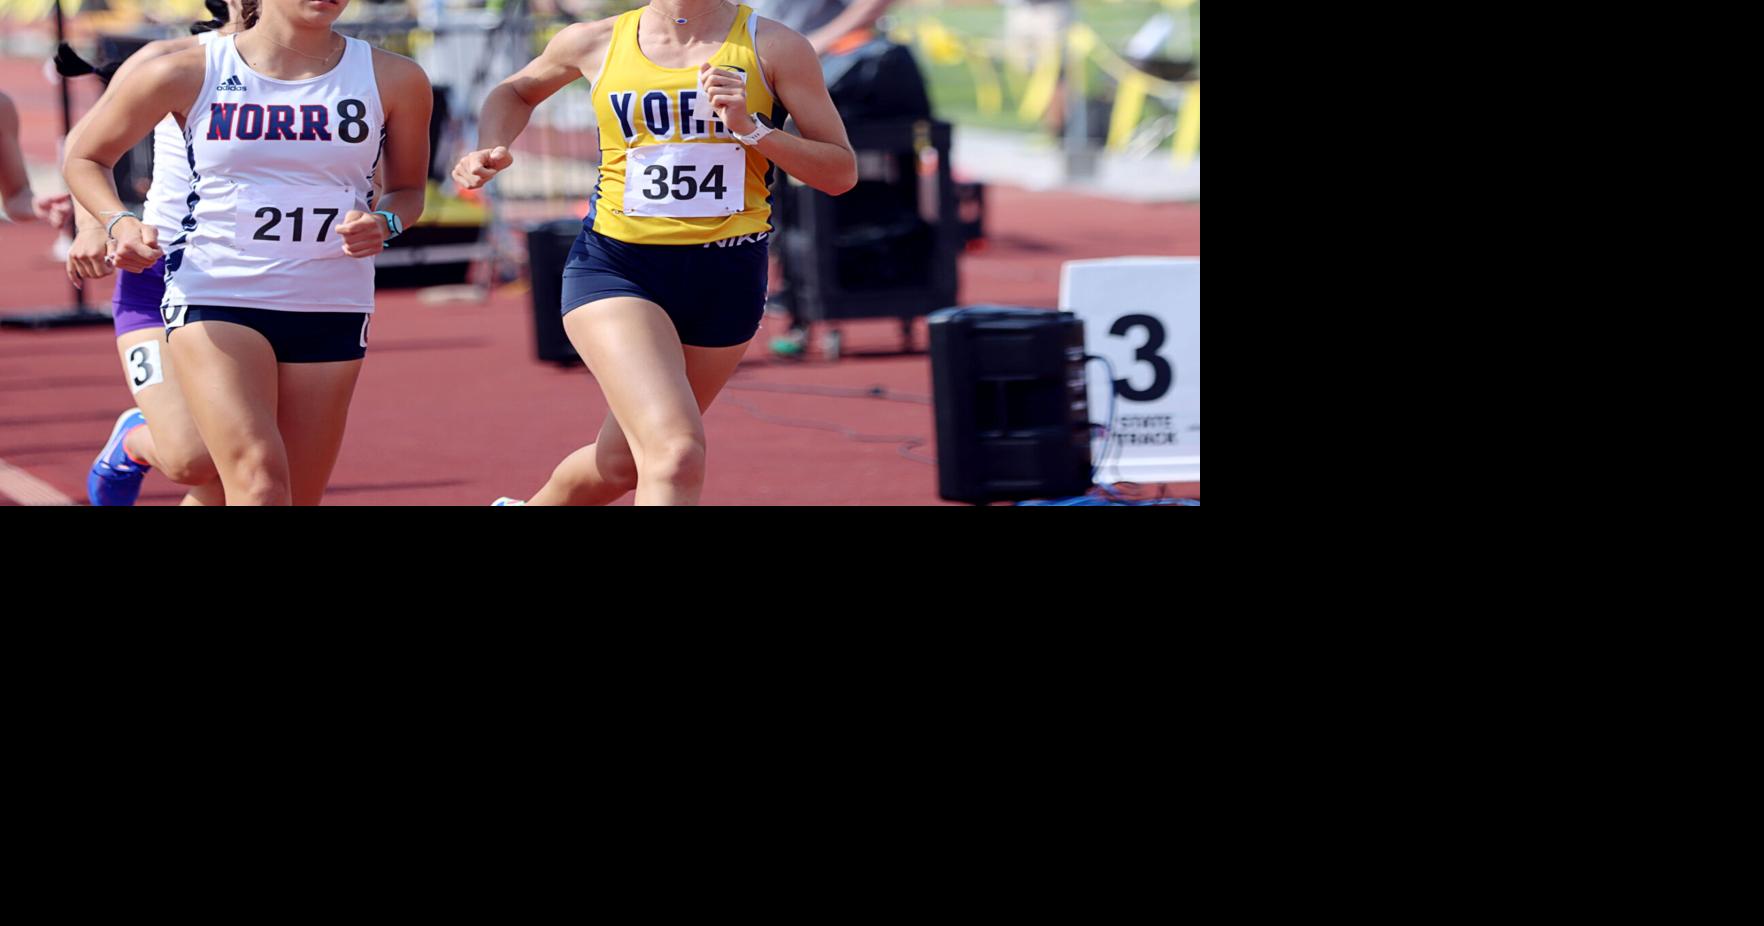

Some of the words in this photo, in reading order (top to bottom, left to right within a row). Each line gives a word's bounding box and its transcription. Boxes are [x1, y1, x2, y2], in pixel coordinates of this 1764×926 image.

[336, 98, 369, 143] 8
[609, 90, 734, 140] YOR
[642, 164, 727, 200] 354
[252, 206, 339, 242] 217
[130, 346, 155, 387] 3
[1109, 313, 1172, 402] 3
